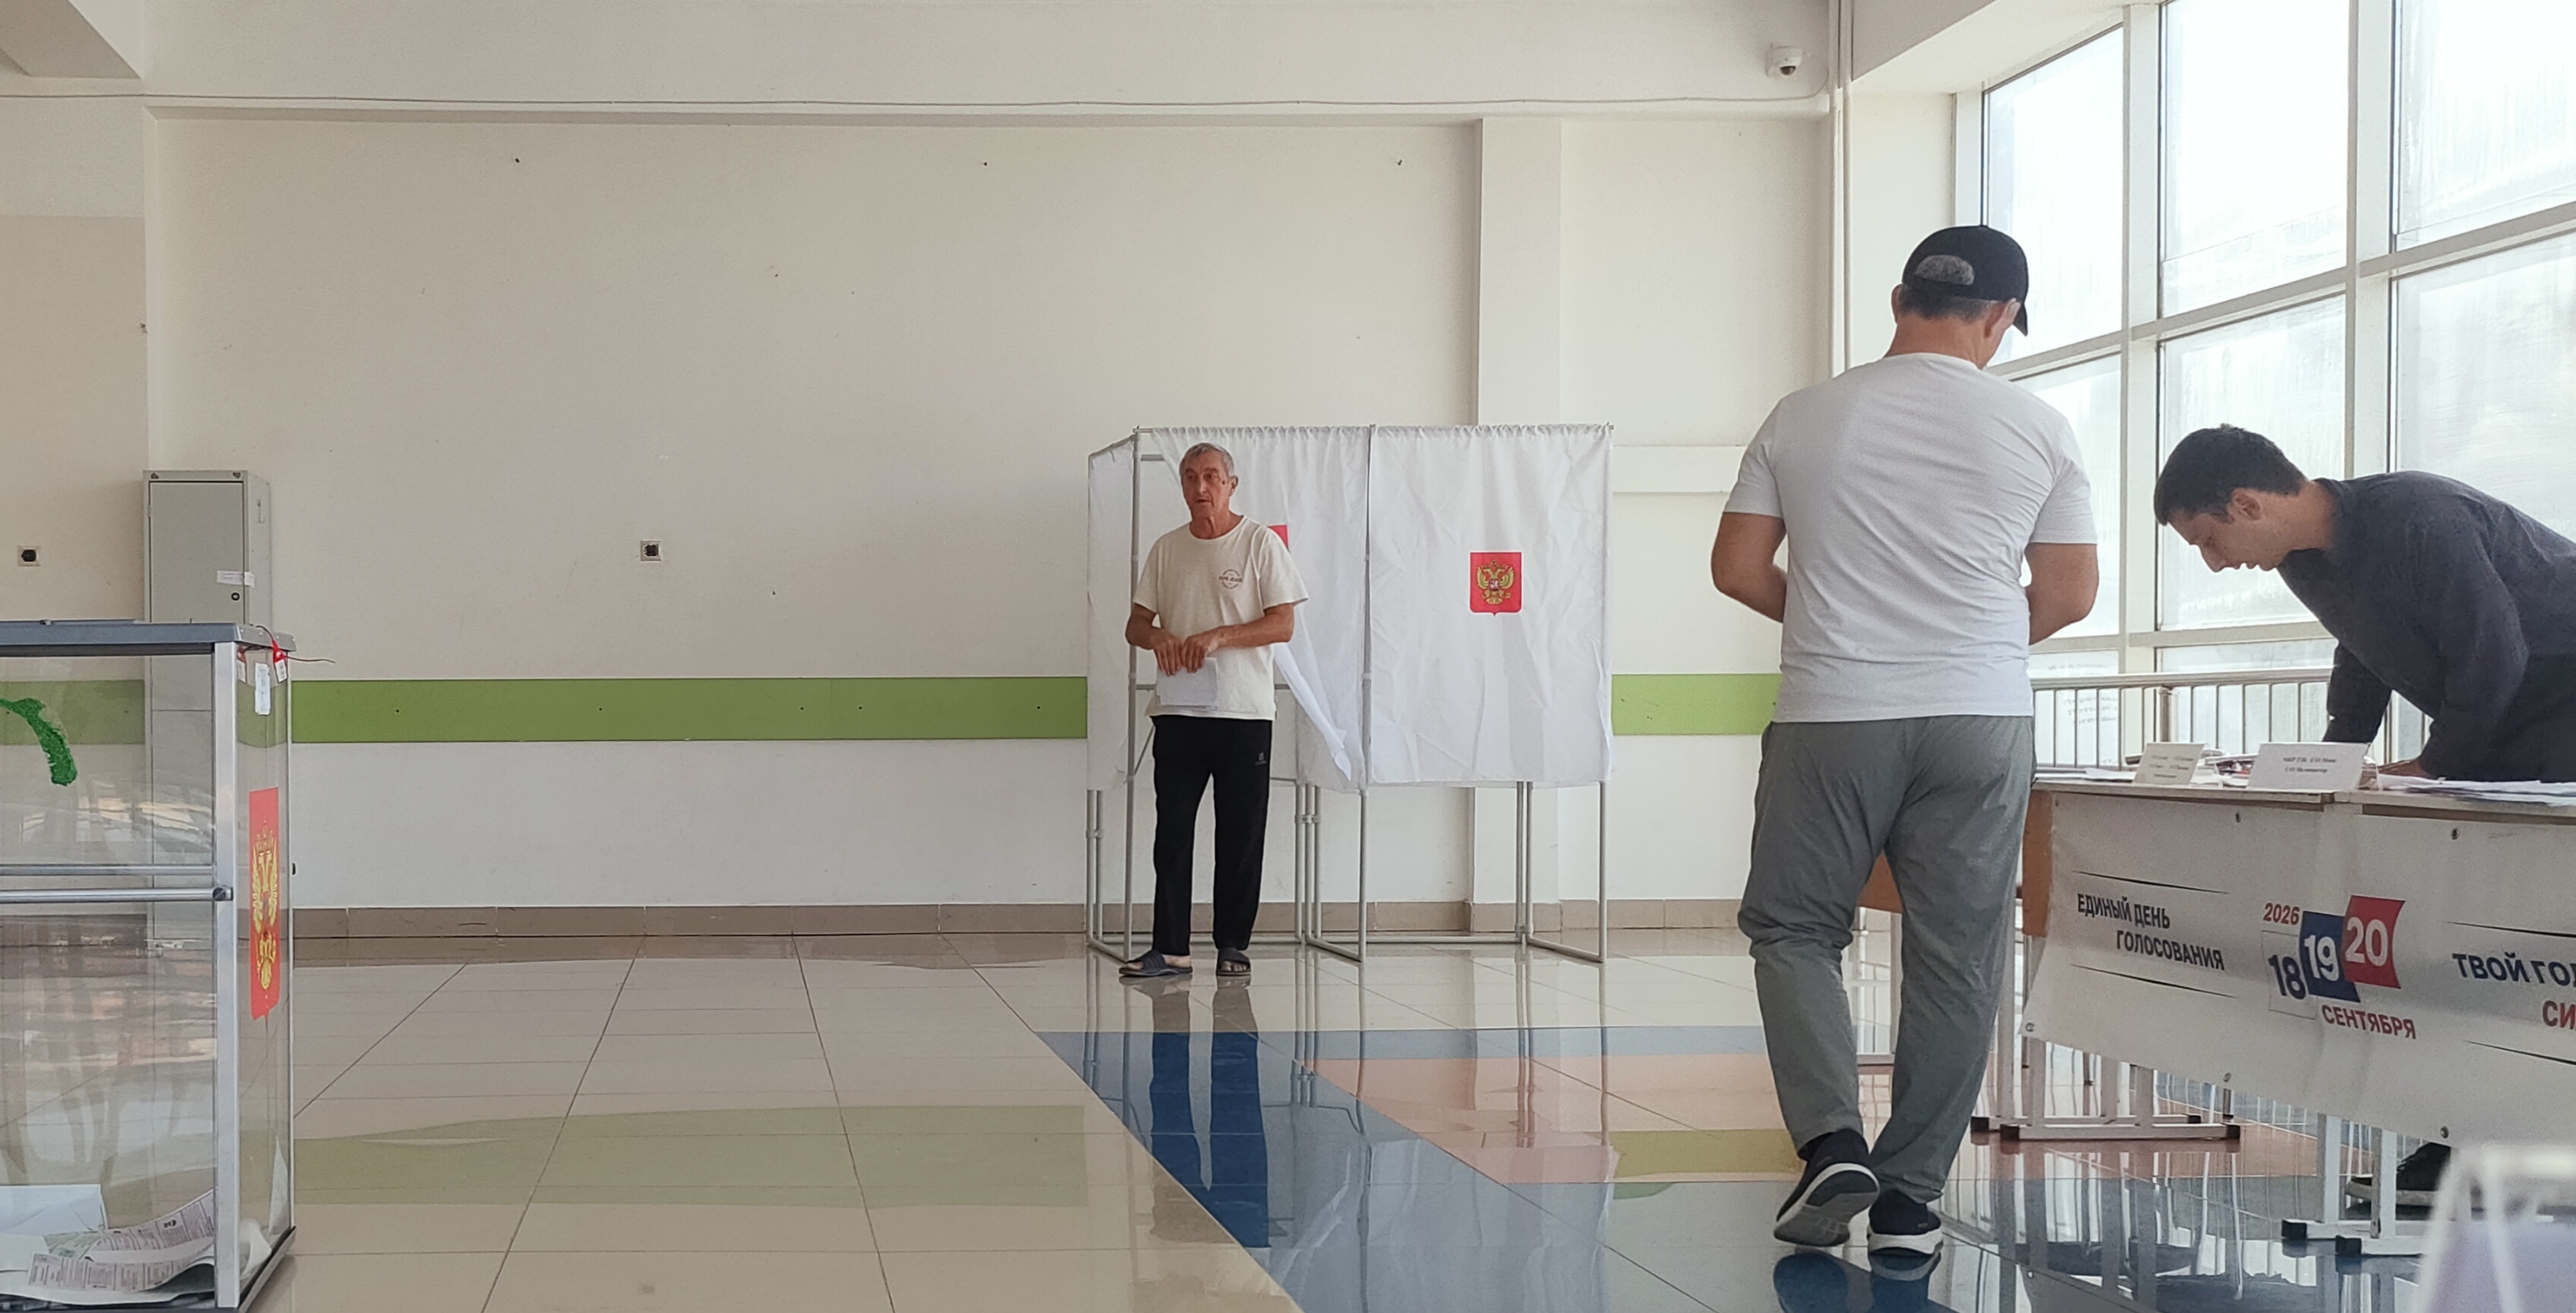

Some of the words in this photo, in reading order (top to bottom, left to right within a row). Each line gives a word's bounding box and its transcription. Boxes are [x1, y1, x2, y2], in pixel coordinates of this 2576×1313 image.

[2077, 893, 2132, 921] ЕДИНЫЙ
[2133, 904, 2171, 929] ДЕНЬ
[2263, 902, 2300, 926] 2026
[2116, 929, 2225, 971] ГОЛОСОВАНИЯ
[2267, 954, 2306, 1000] 18
[2304, 934, 2340, 982] 19
[2344, 916, 2389, 967] 20
[2451, 951, 2531, 983] ТВОЙ
[2321, 1004, 2417, 1040] СЕНТЯБРЯ
[2542, 999, 2576, 1031] СИ
